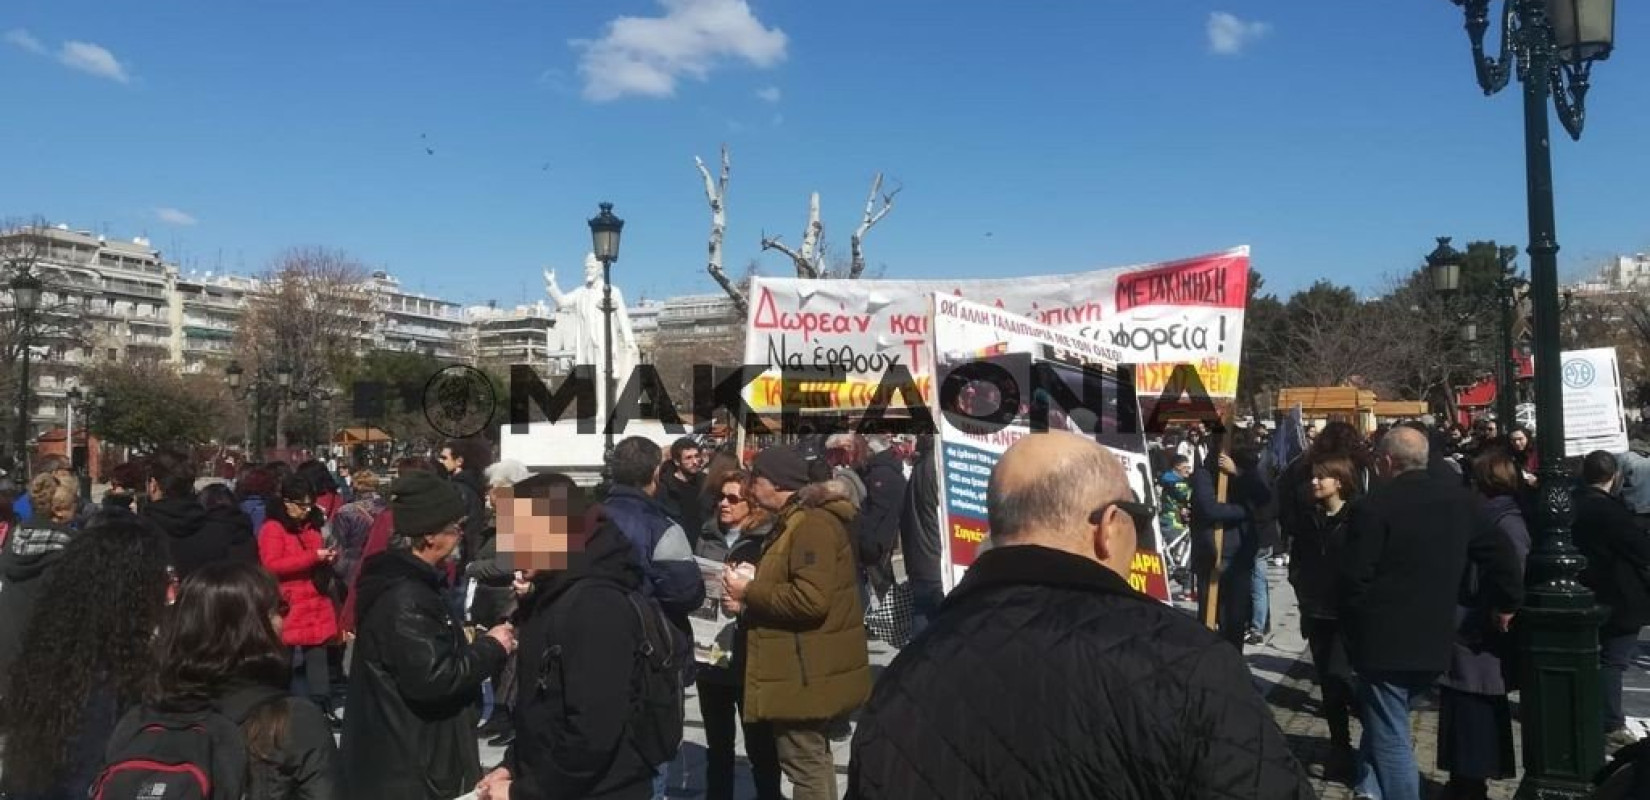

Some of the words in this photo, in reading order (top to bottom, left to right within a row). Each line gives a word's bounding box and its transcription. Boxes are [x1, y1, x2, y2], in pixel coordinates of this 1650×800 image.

[754, 286, 871, 343] Δωρεάν
[890, 314, 928, 335] και
[1116, 266, 1227, 313] ΜΕΤΑΚΙΝΗΣΗ
[767, 333, 804, 372] Να
[813, 337, 900, 375] έρθουν
